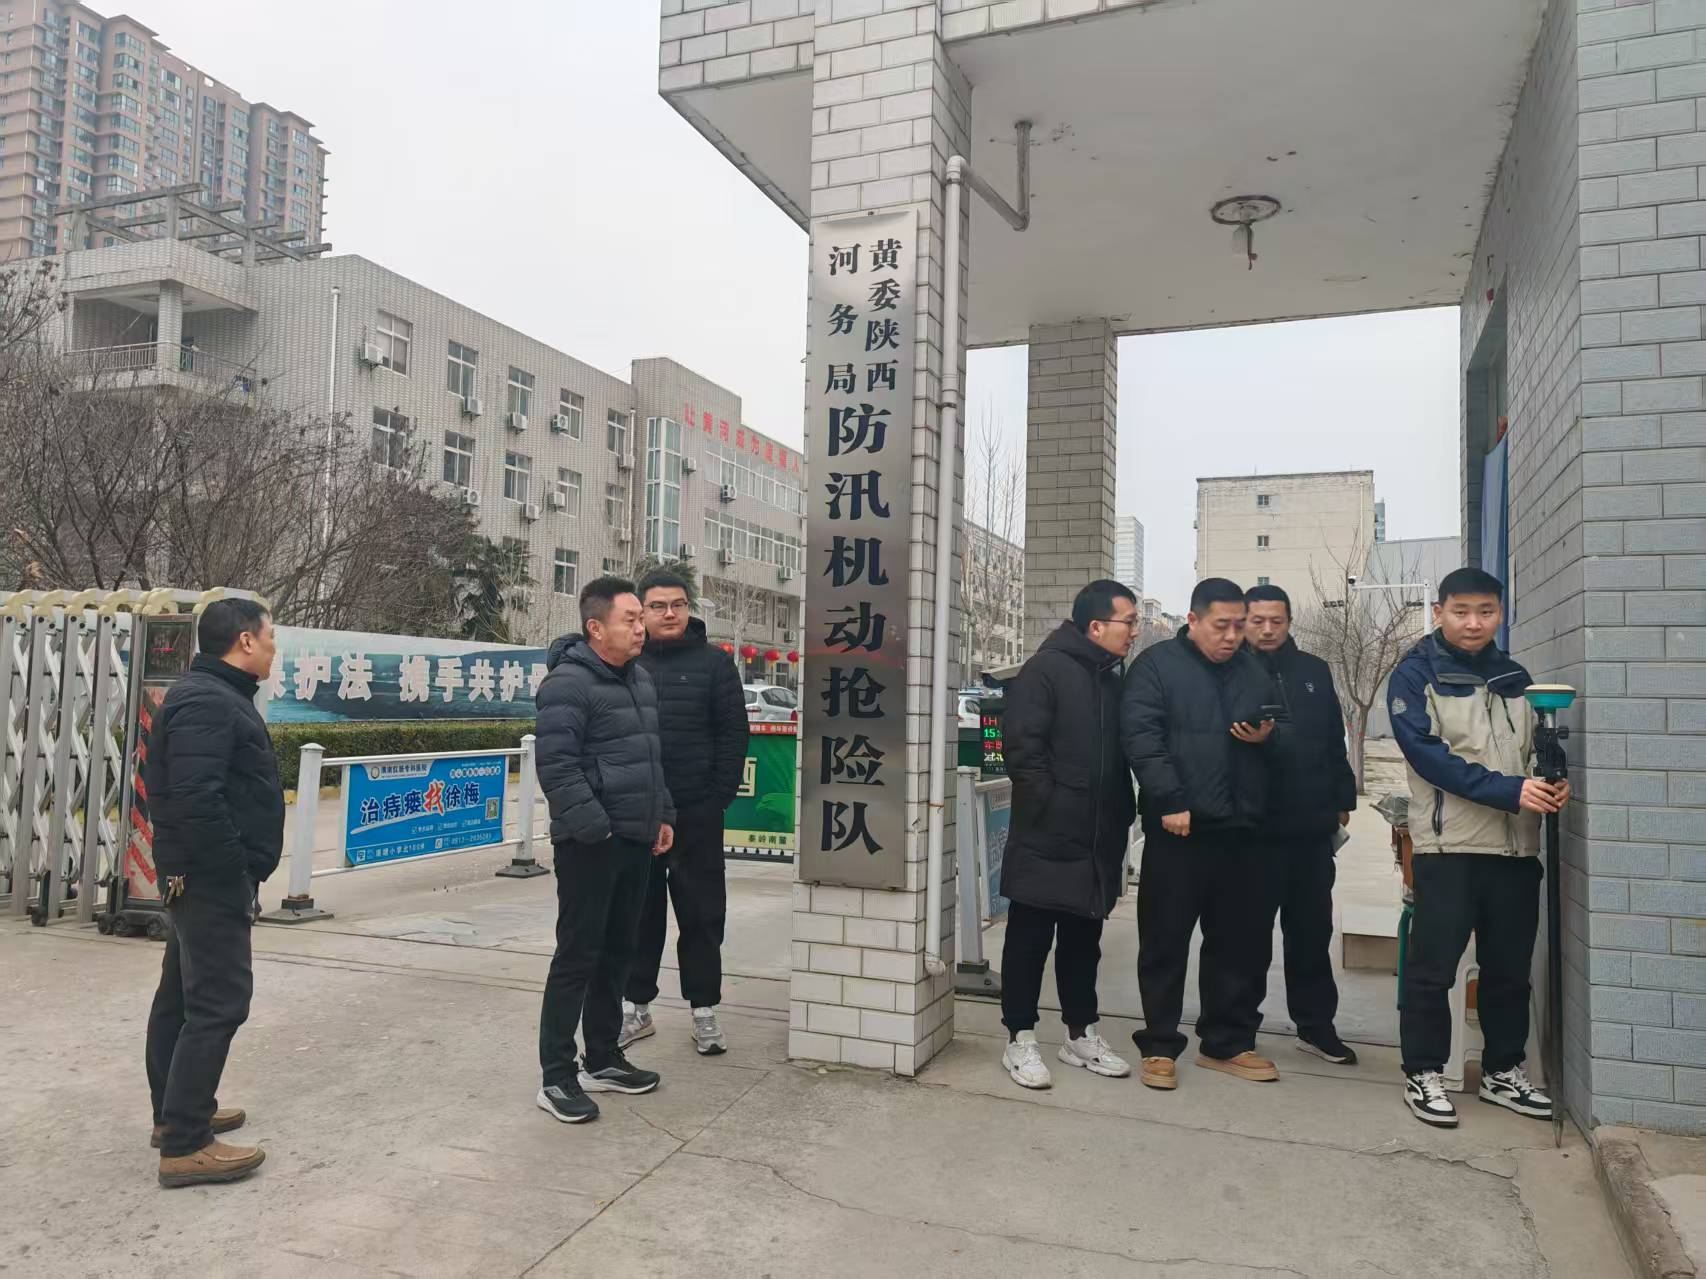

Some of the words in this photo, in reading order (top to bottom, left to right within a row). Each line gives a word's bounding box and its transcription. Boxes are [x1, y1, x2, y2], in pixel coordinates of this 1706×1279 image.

[824, 242, 862, 396] 河务局
[865, 238, 902, 392] 黄委陕西
[819, 403, 893, 855] 防汛机动抢险队
[360, 779, 480, 827] 治痔瘘找徐梅
